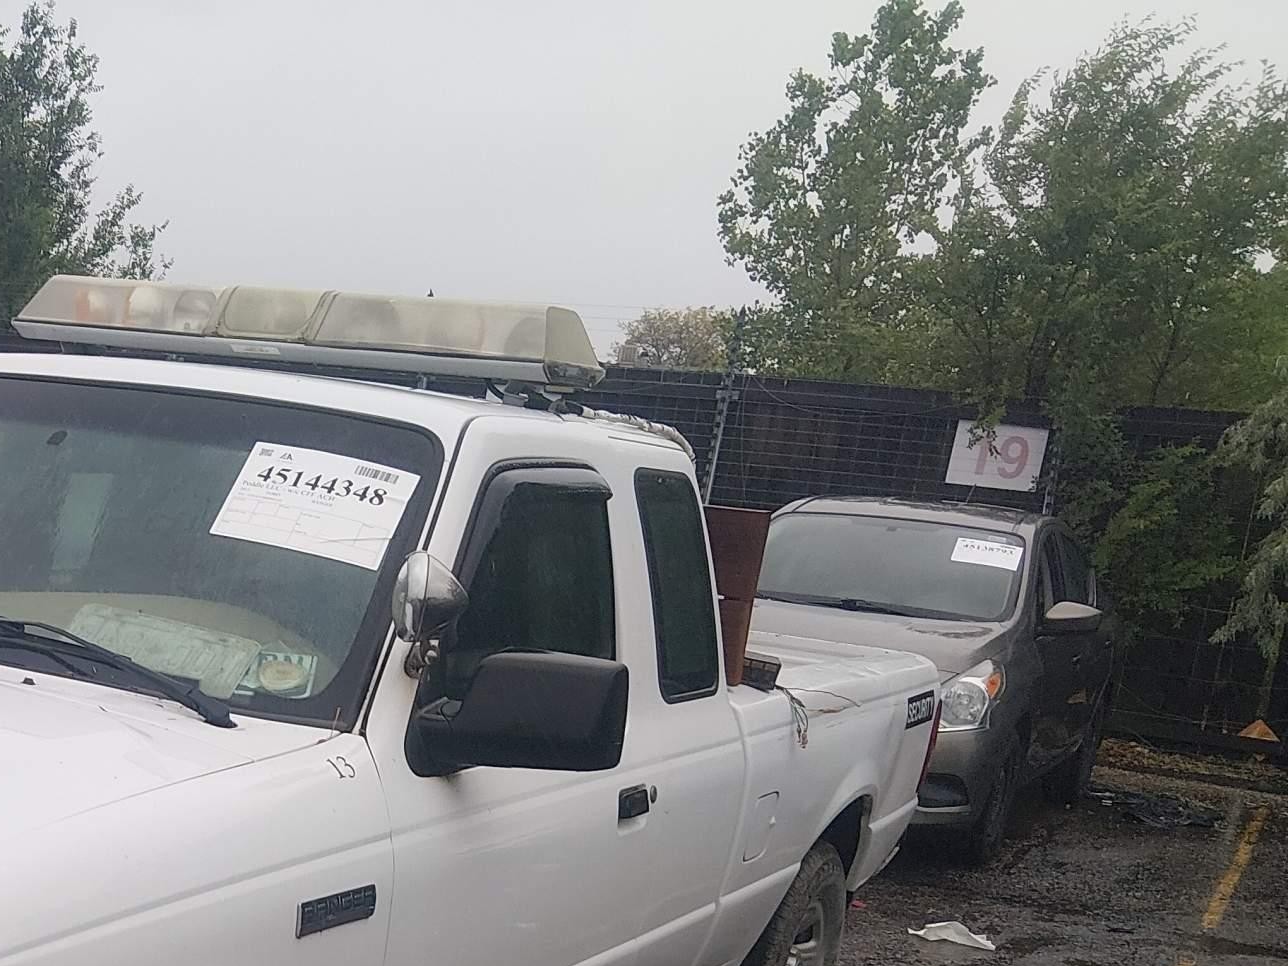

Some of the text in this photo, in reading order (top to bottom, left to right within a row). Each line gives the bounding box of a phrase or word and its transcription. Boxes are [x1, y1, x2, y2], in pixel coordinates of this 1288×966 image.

[973, 435, 1030, 480] 19
[257, 465, 388, 506] 45144348
[907, 696, 934, 723] SECURITY
[326, 756, 357, 780] 13
